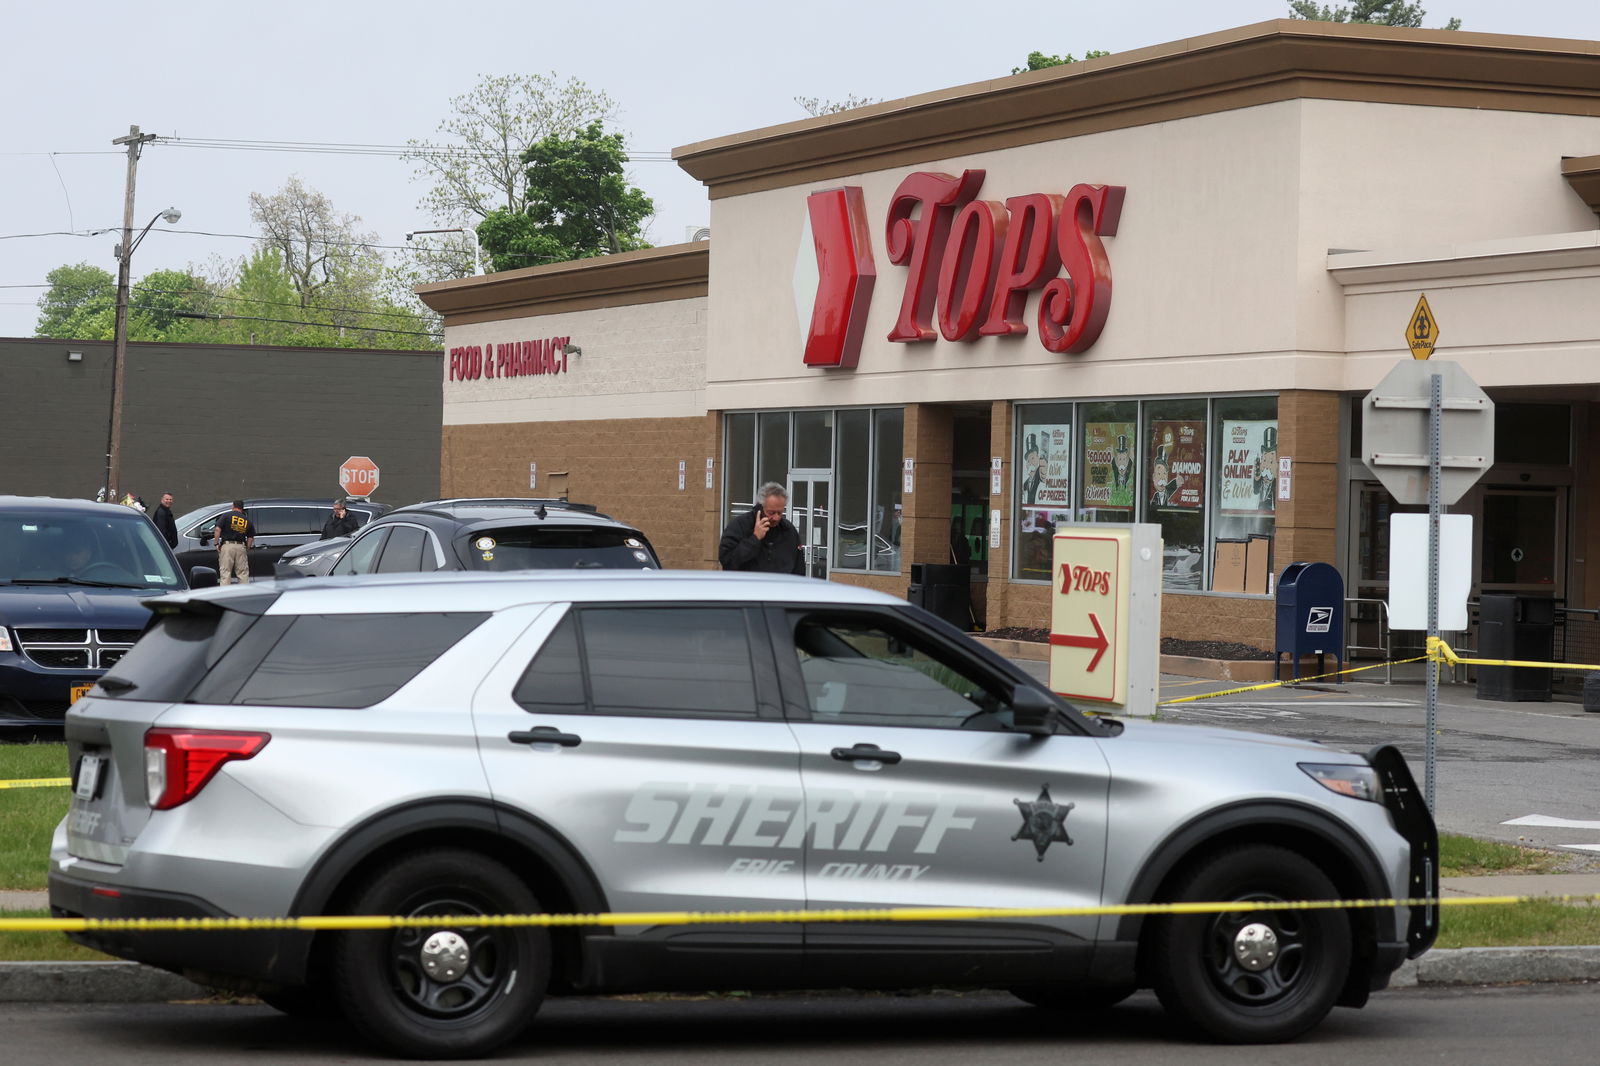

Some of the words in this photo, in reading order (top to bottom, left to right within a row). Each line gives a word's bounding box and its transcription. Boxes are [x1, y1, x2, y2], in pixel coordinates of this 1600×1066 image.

[885, 169, 1126, 353] TOPS
[449, 346, 482, 381] FOOD
[484, 344, 494, 379] &
[496, 336, 570, 378] PHARMACY
[1228, 449, 1250, 463] PLAY
[1171, 461, 1201, 474] DIAMOND
[1223, 464, 1253, 479] ONLINE
[341, 468, 378, 484] STOP
[1045, 478, 1067, 488] MILLIONS
[1038, 490, 1047, 500] OF
[231, 515, 248, 529] FBI
[1073, 565, 1111, 597] TOPS
[613, 780, 985, 854] SHERIFF
[725, 857, 796, 877] ERIE
[816, 861, 931, 882] COUNTY
